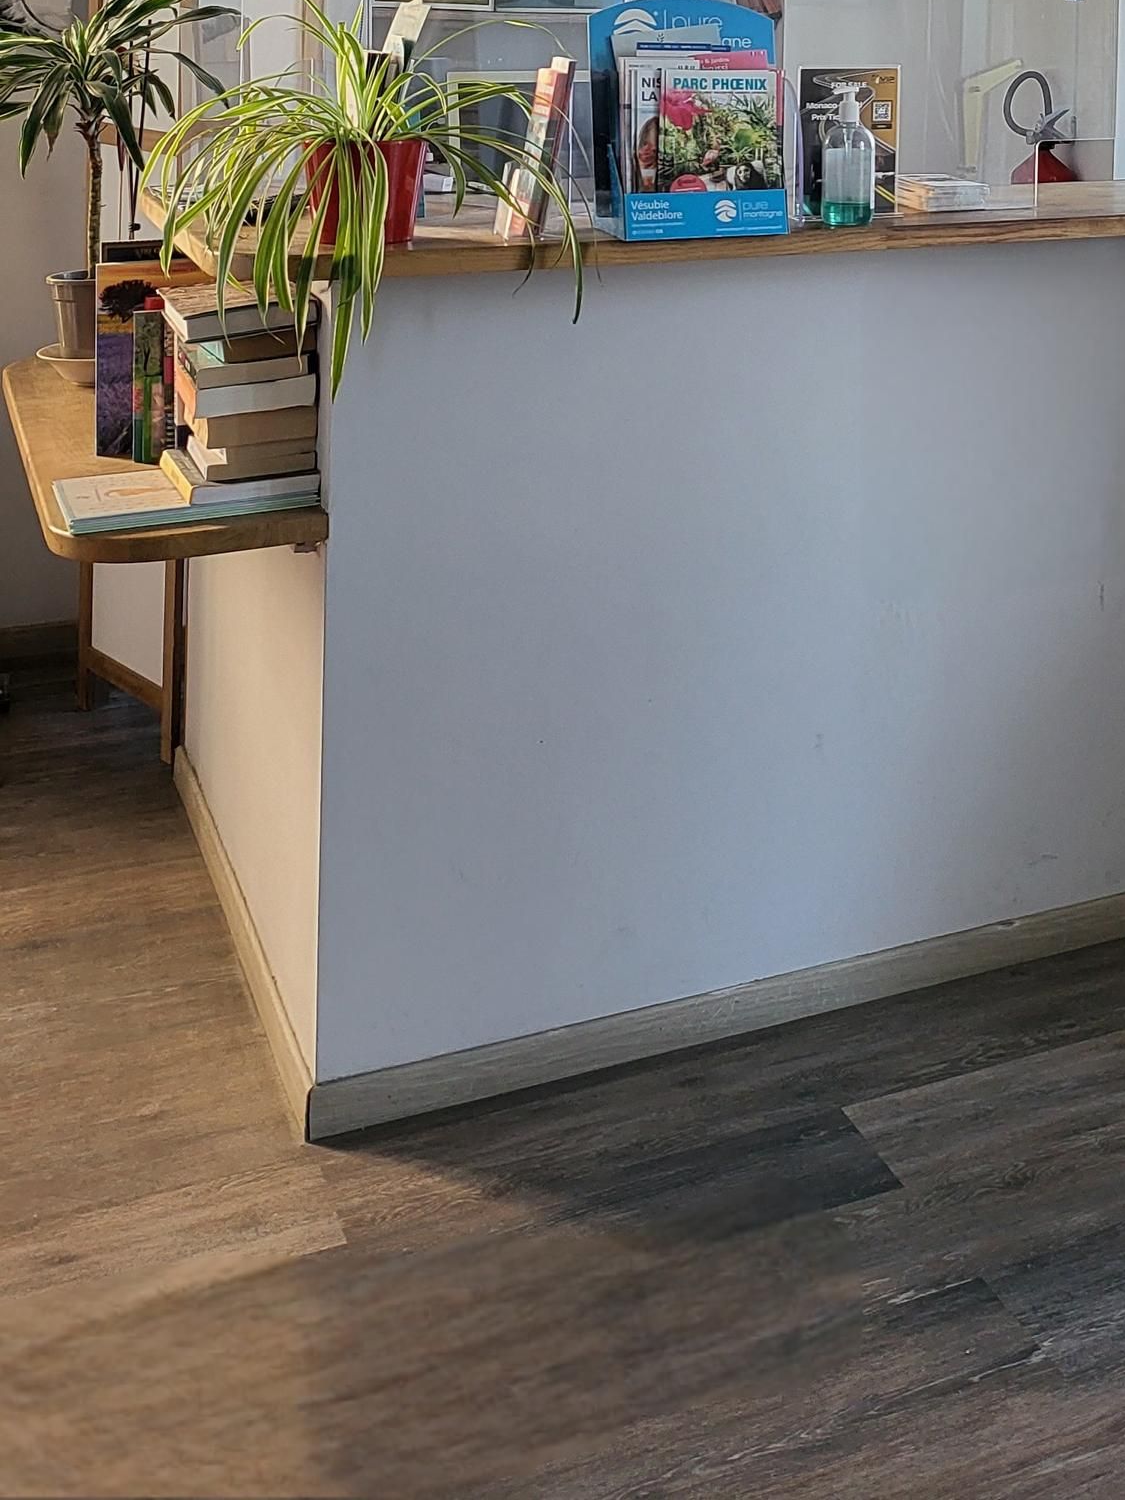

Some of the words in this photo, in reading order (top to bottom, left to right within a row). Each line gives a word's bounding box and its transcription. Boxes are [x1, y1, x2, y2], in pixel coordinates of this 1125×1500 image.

[672, 14, 723, 30] pure
[673, 78, 709, 91] PARC
[712, 77, 768, 91] PHŒNIX
[831, 81, 848, 89] FOR
[849, 81, 868, 89] SALE
[630, 199, 670, 210] Vésubie
[631, 210, 683, 221] Valdeblore
[743, 209, 783, 219] montagne
